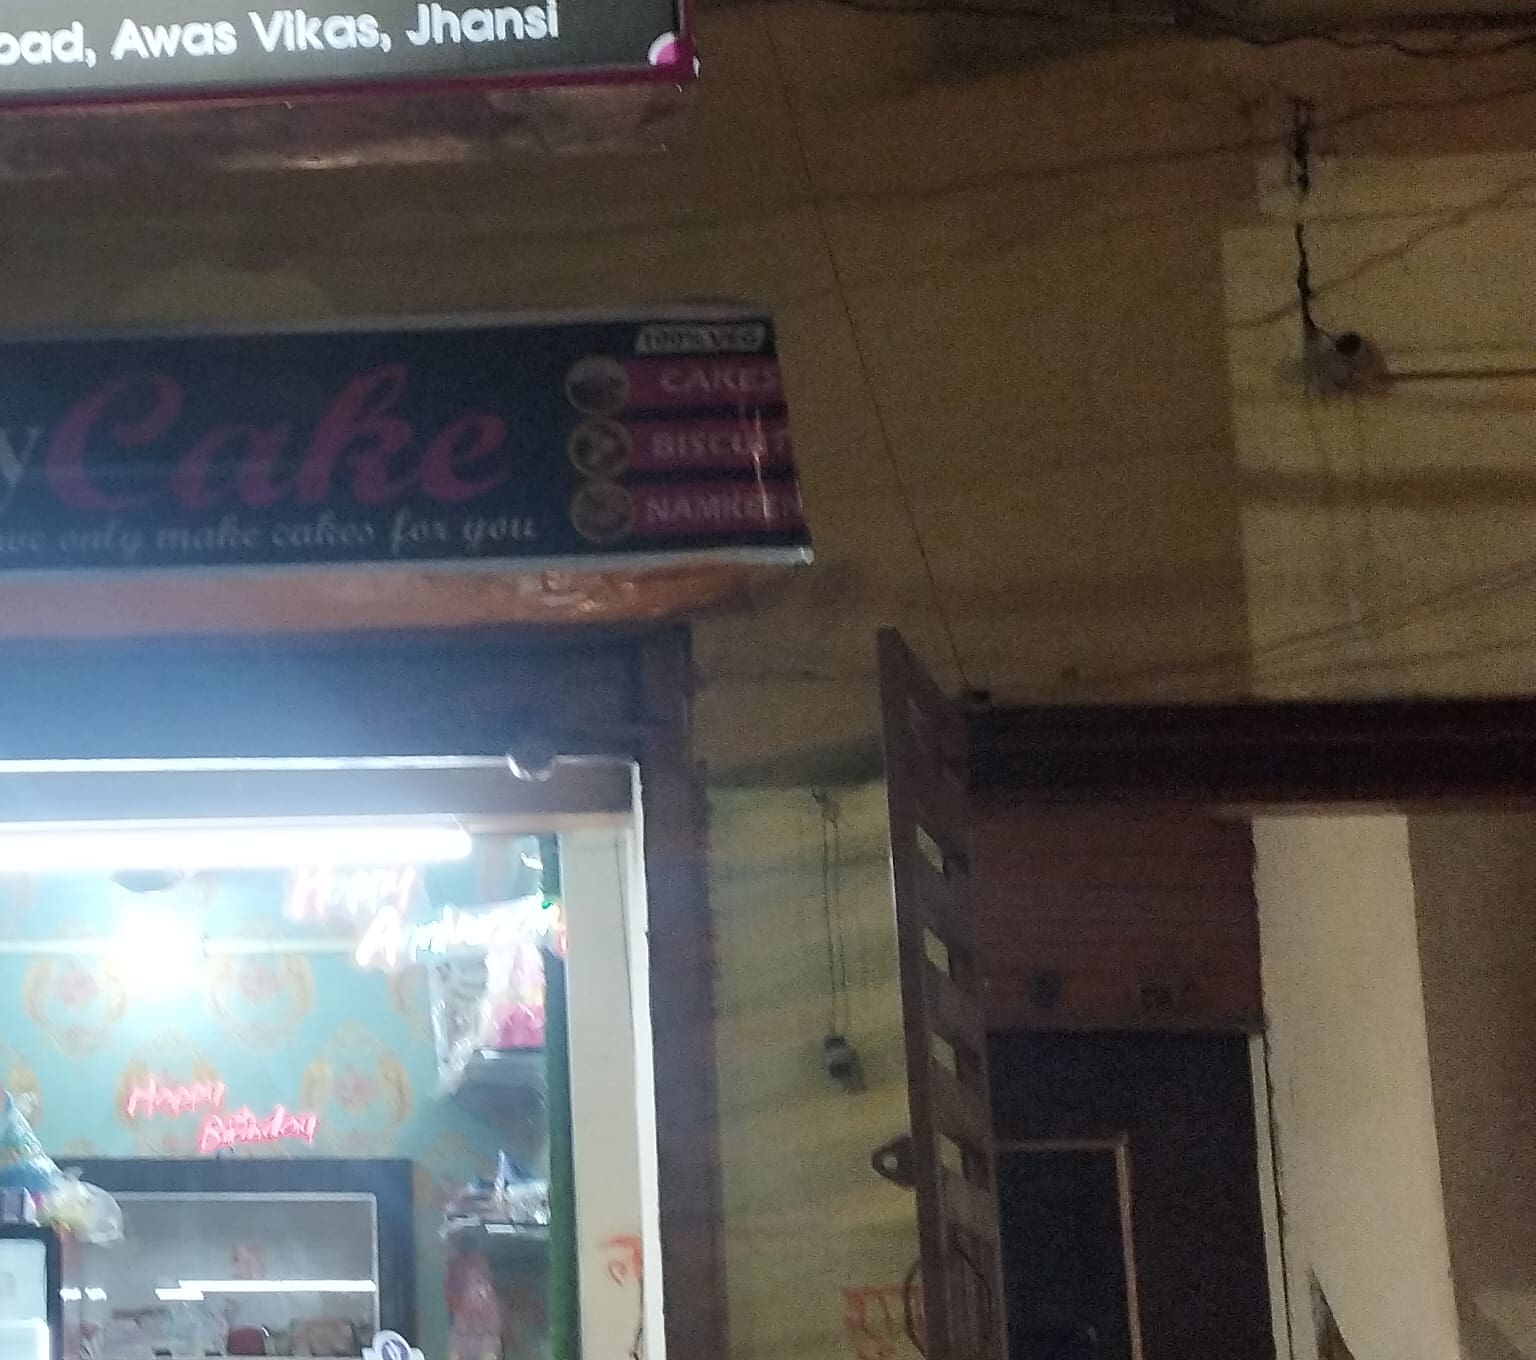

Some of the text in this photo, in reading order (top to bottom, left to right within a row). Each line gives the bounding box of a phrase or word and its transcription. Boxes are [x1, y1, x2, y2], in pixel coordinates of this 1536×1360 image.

[110, 16, 238, 61] Awas
[250, 9, 393, 56] Vikas,
[659, 366, 779, 393] CAKES
[45, 361, 513, 513] Cake
[652, 428, 789, 460] BISCUT
